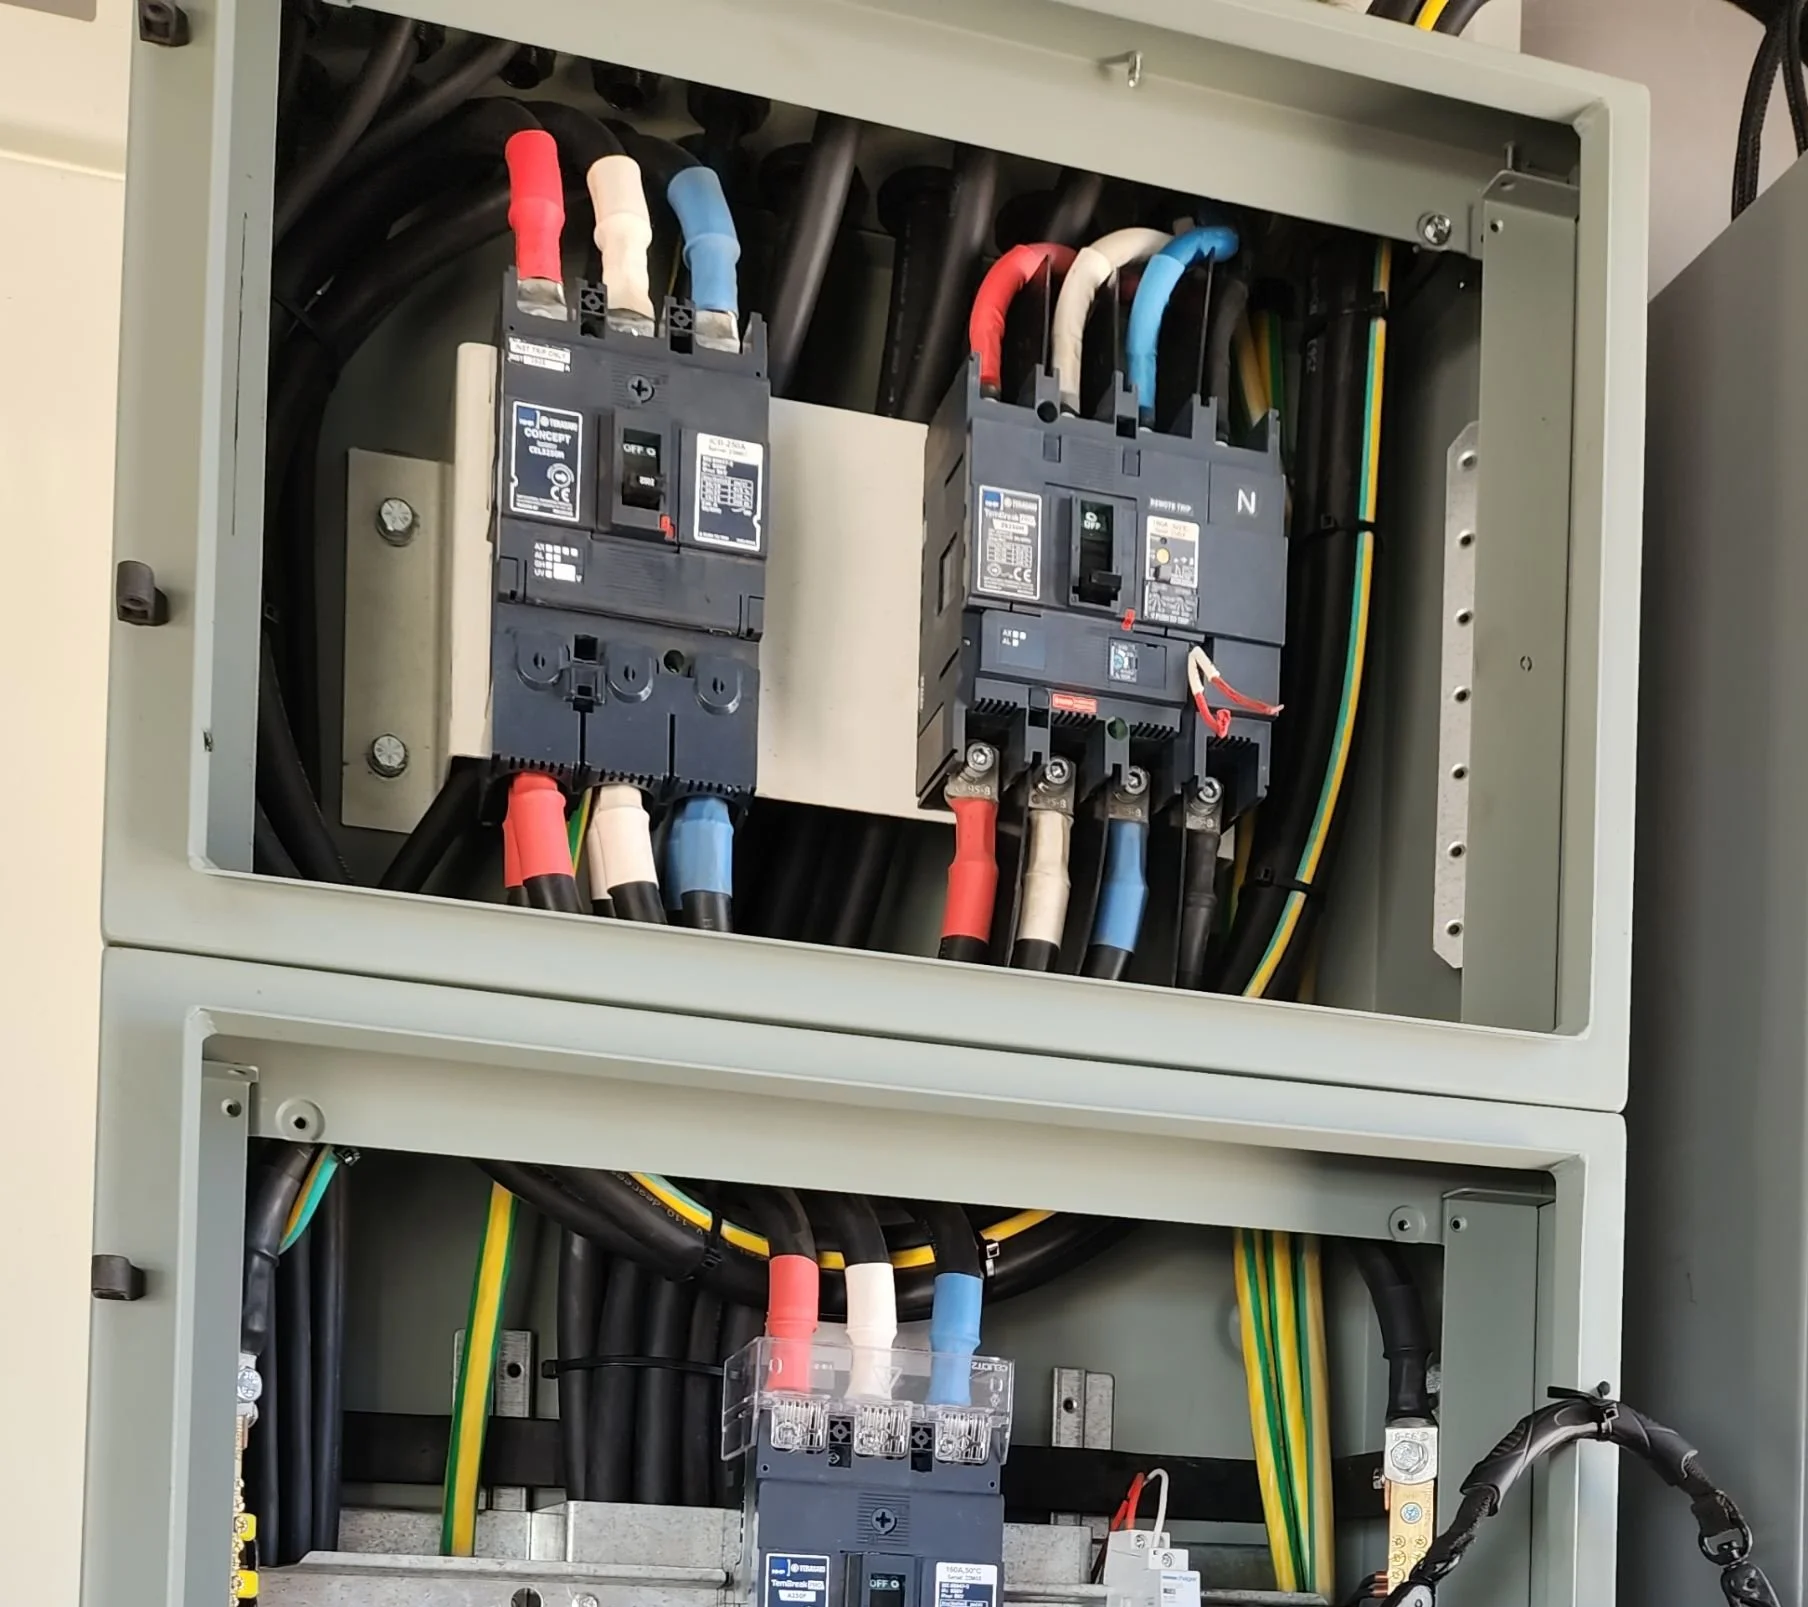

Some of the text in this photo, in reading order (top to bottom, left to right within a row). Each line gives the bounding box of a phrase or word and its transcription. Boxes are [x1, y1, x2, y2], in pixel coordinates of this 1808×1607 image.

[524, 427, 572, 446] CONCEPT
[623, 443, 643, 455] OFF
[1237, 488, 1256, 514] N
[1014, 567, 1032, 582] CE
[869, 1579, 889, 1588] OFF
